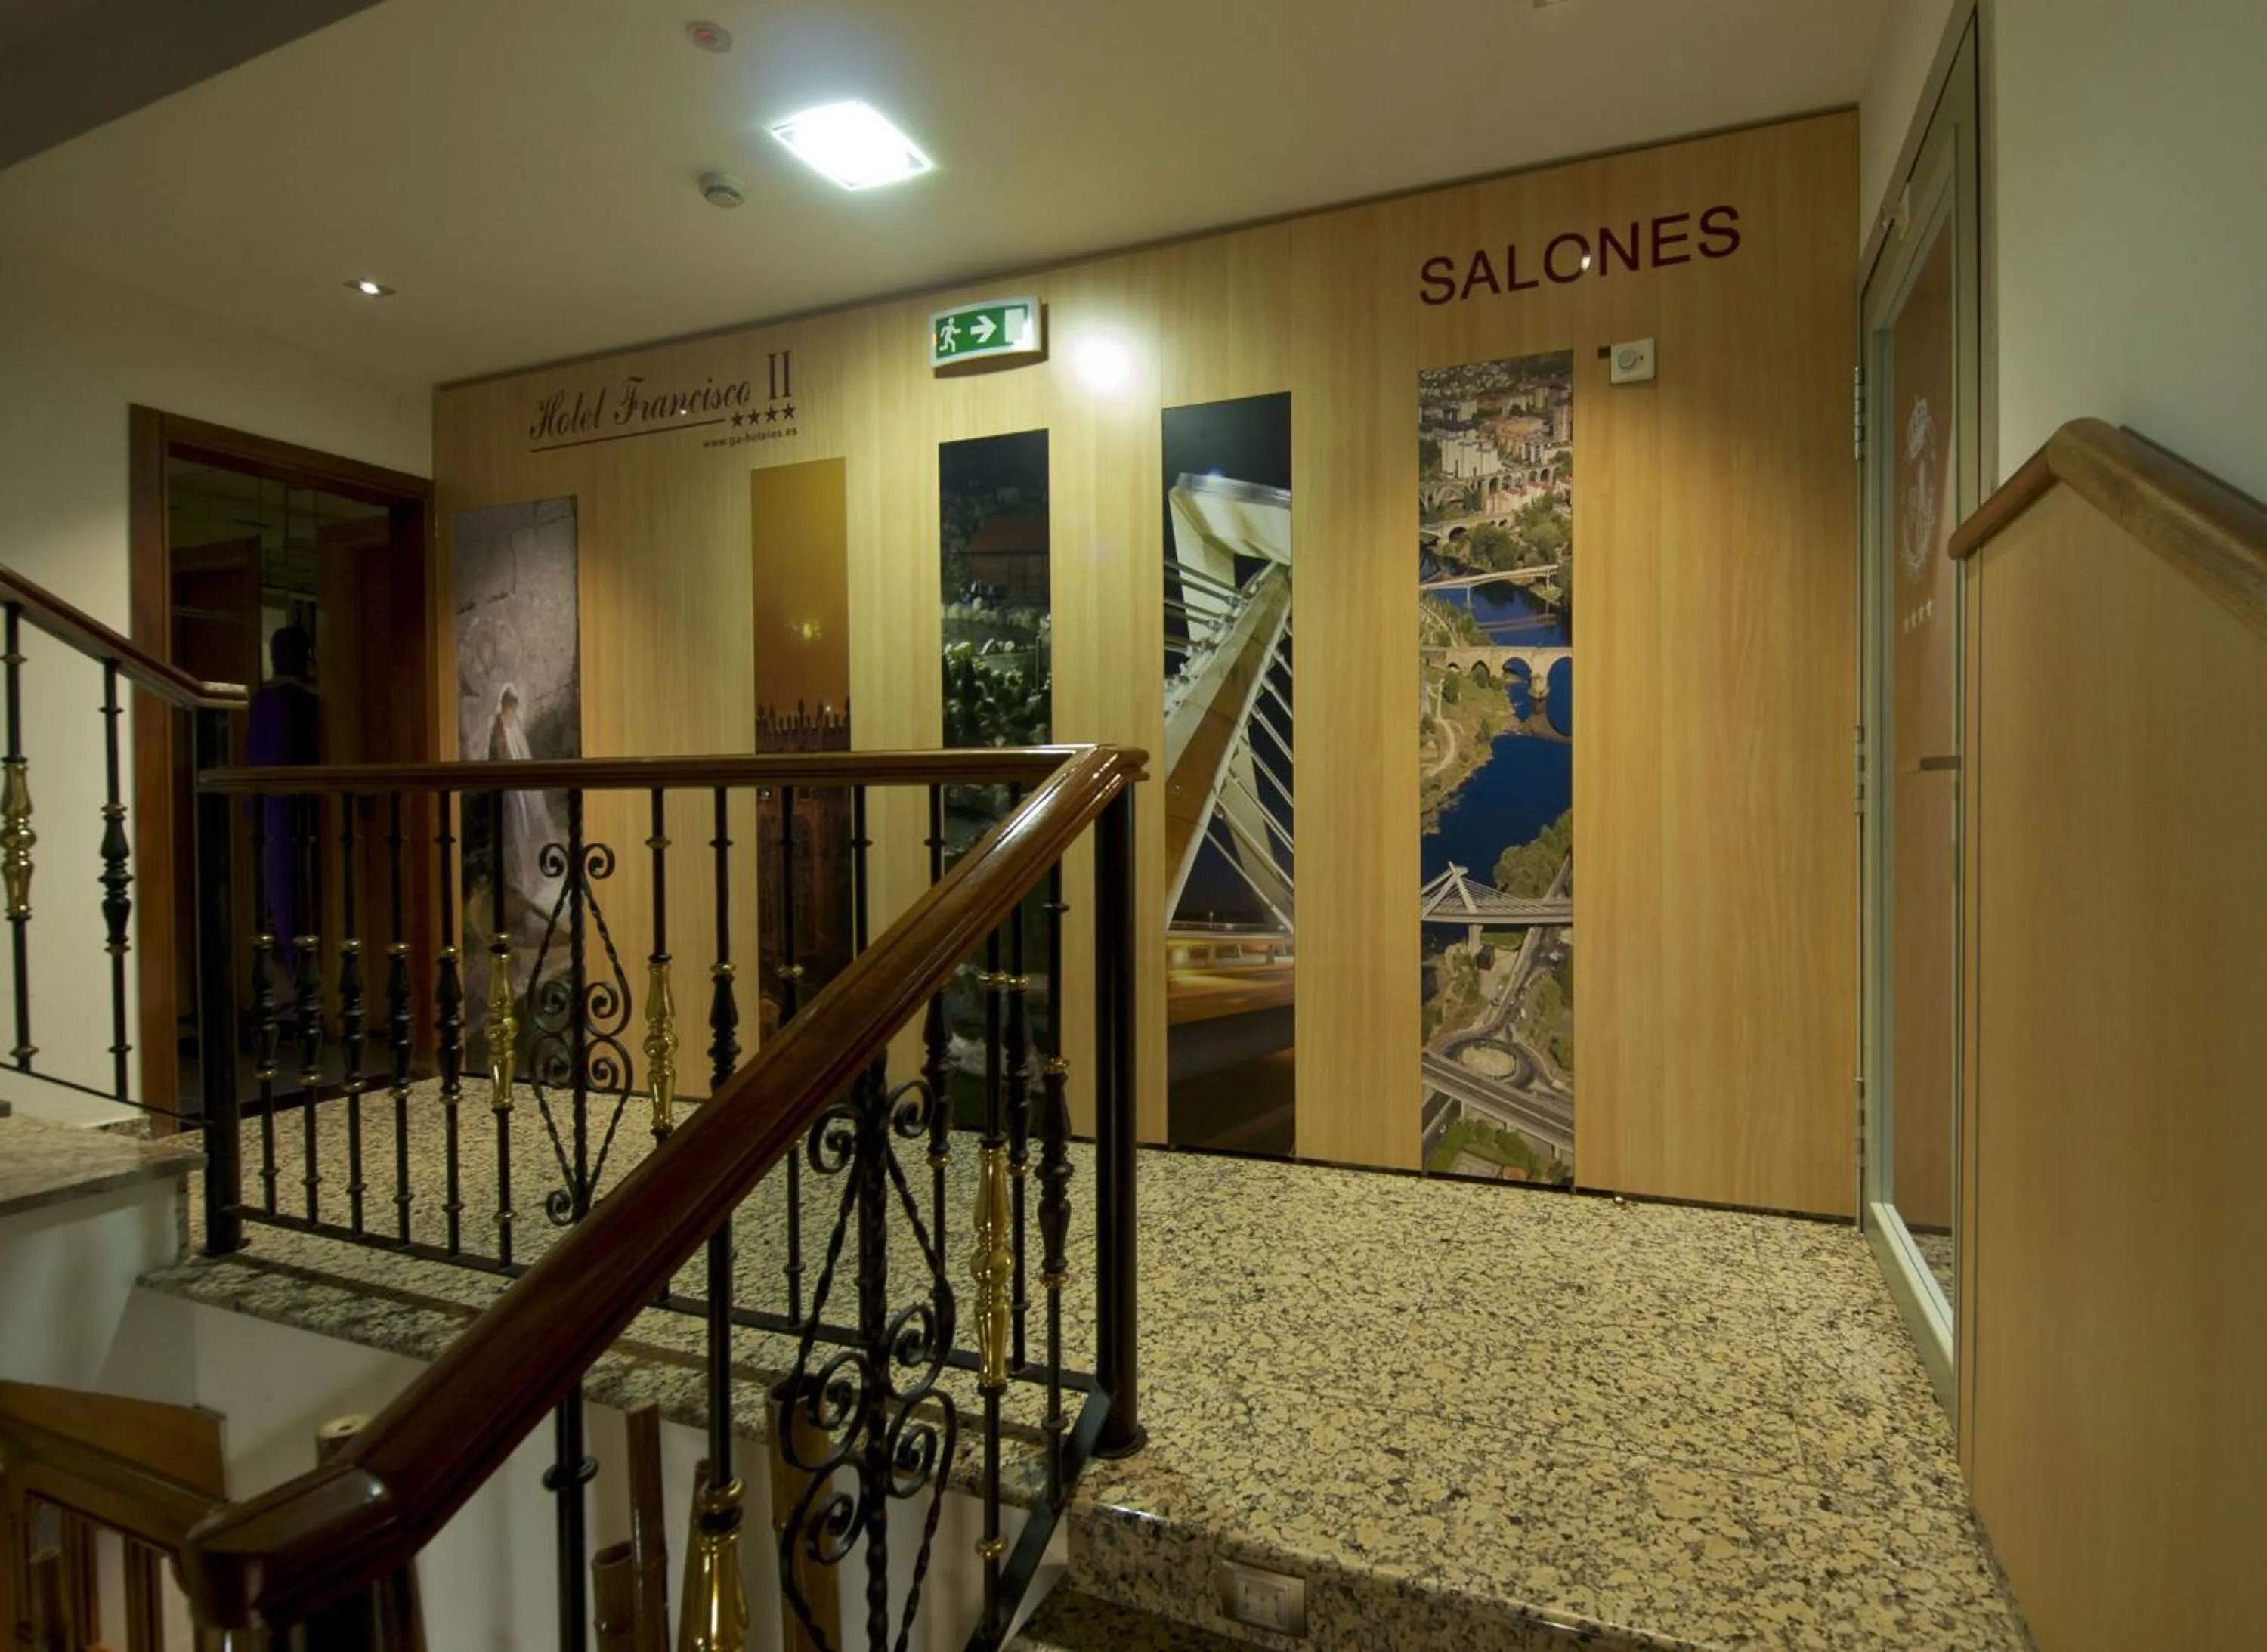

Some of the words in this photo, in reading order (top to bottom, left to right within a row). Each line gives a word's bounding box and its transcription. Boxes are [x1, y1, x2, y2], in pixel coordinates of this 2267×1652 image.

[1419, 205, 1741, 306] SALONES
[530, 387, 606, 441] Hotel
[614, 376, 751, 426] Francisco
[767, 350, 793, 401] II
